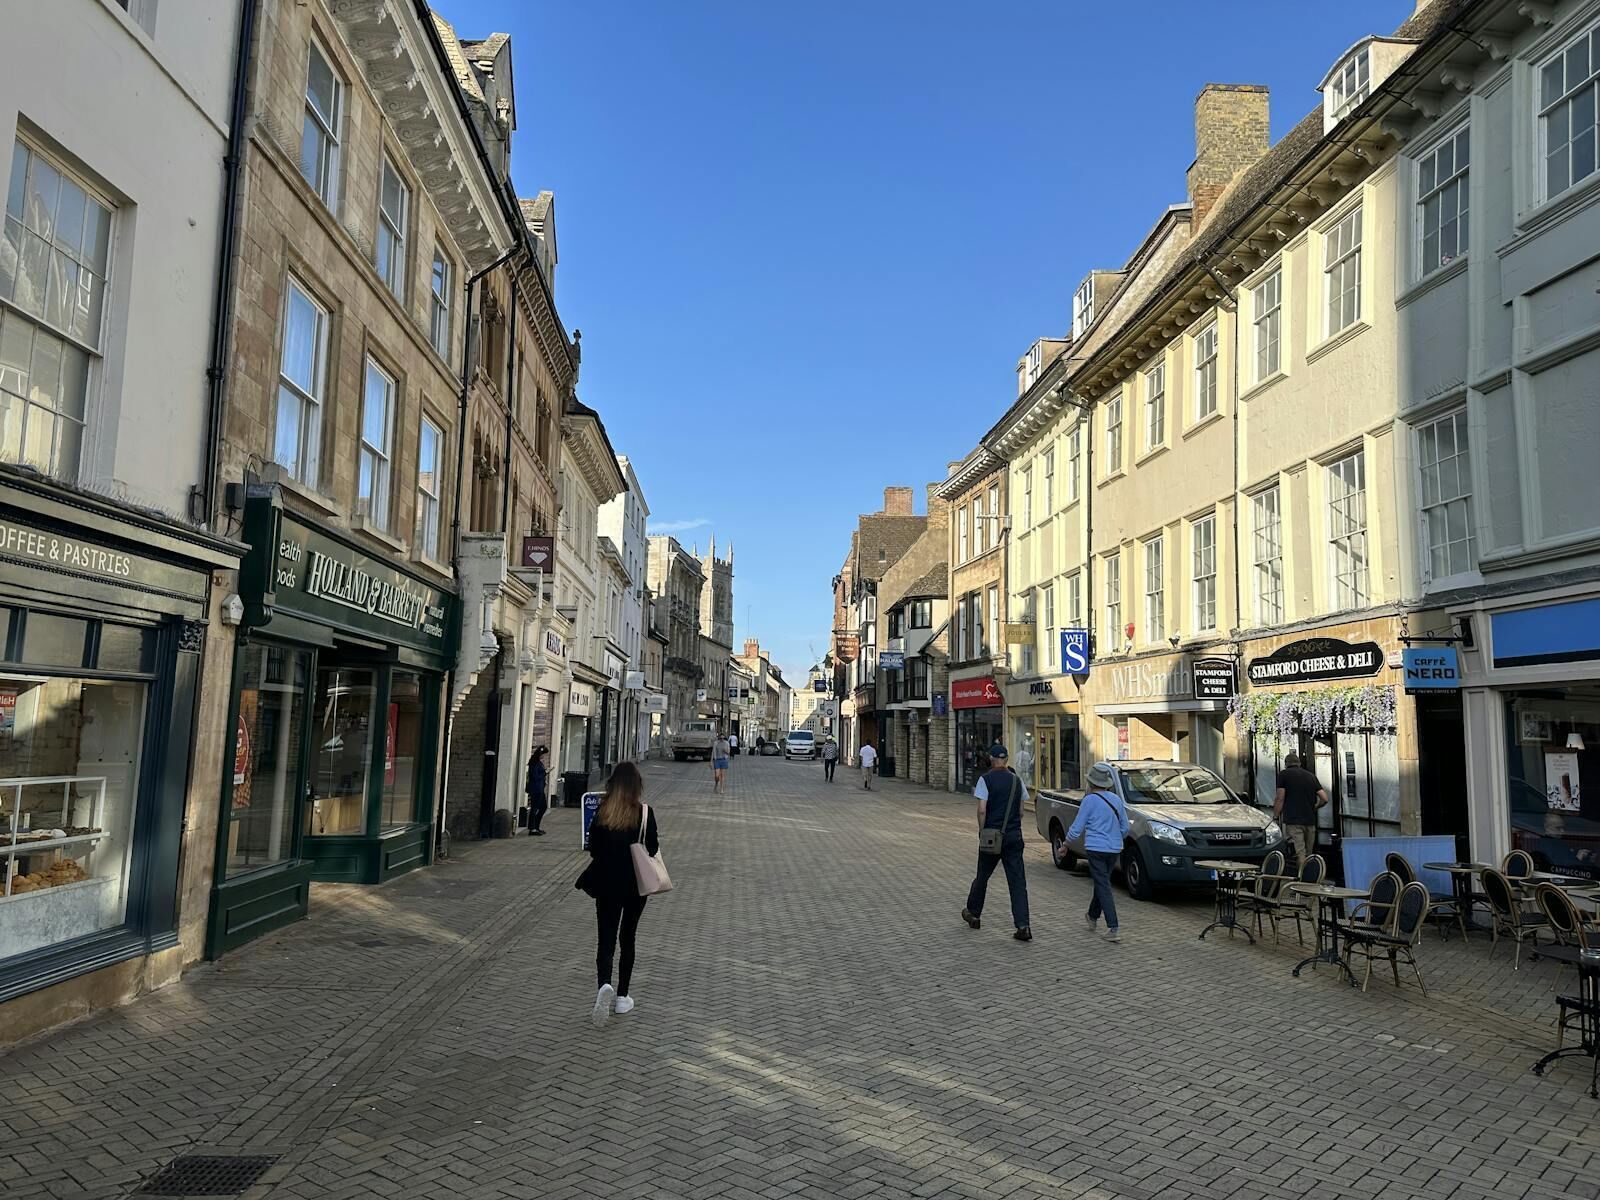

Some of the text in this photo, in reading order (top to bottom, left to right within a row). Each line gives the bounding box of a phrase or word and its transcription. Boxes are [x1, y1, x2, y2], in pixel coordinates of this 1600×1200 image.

[0, 525, 131, 576] OFFEE & PASTRIES
[306, 552, 424, 630] HOLLAND & BARRETT
[1065, 634, 1084, 643] WH
[1065, 642, 1086, 671] S
[1252, 651, 1373, 679] STAMFORD CHEESE & DELI
[1112, 659, 1192, 700] WHSmith
[1195, 669, 1233, 677] STAMFORD
[1407, 668, 1455, 679] NERO
[1029, 681, 1053, 695] JOULES
[1550, 865, 1592, 879] CAPPUCCINO
